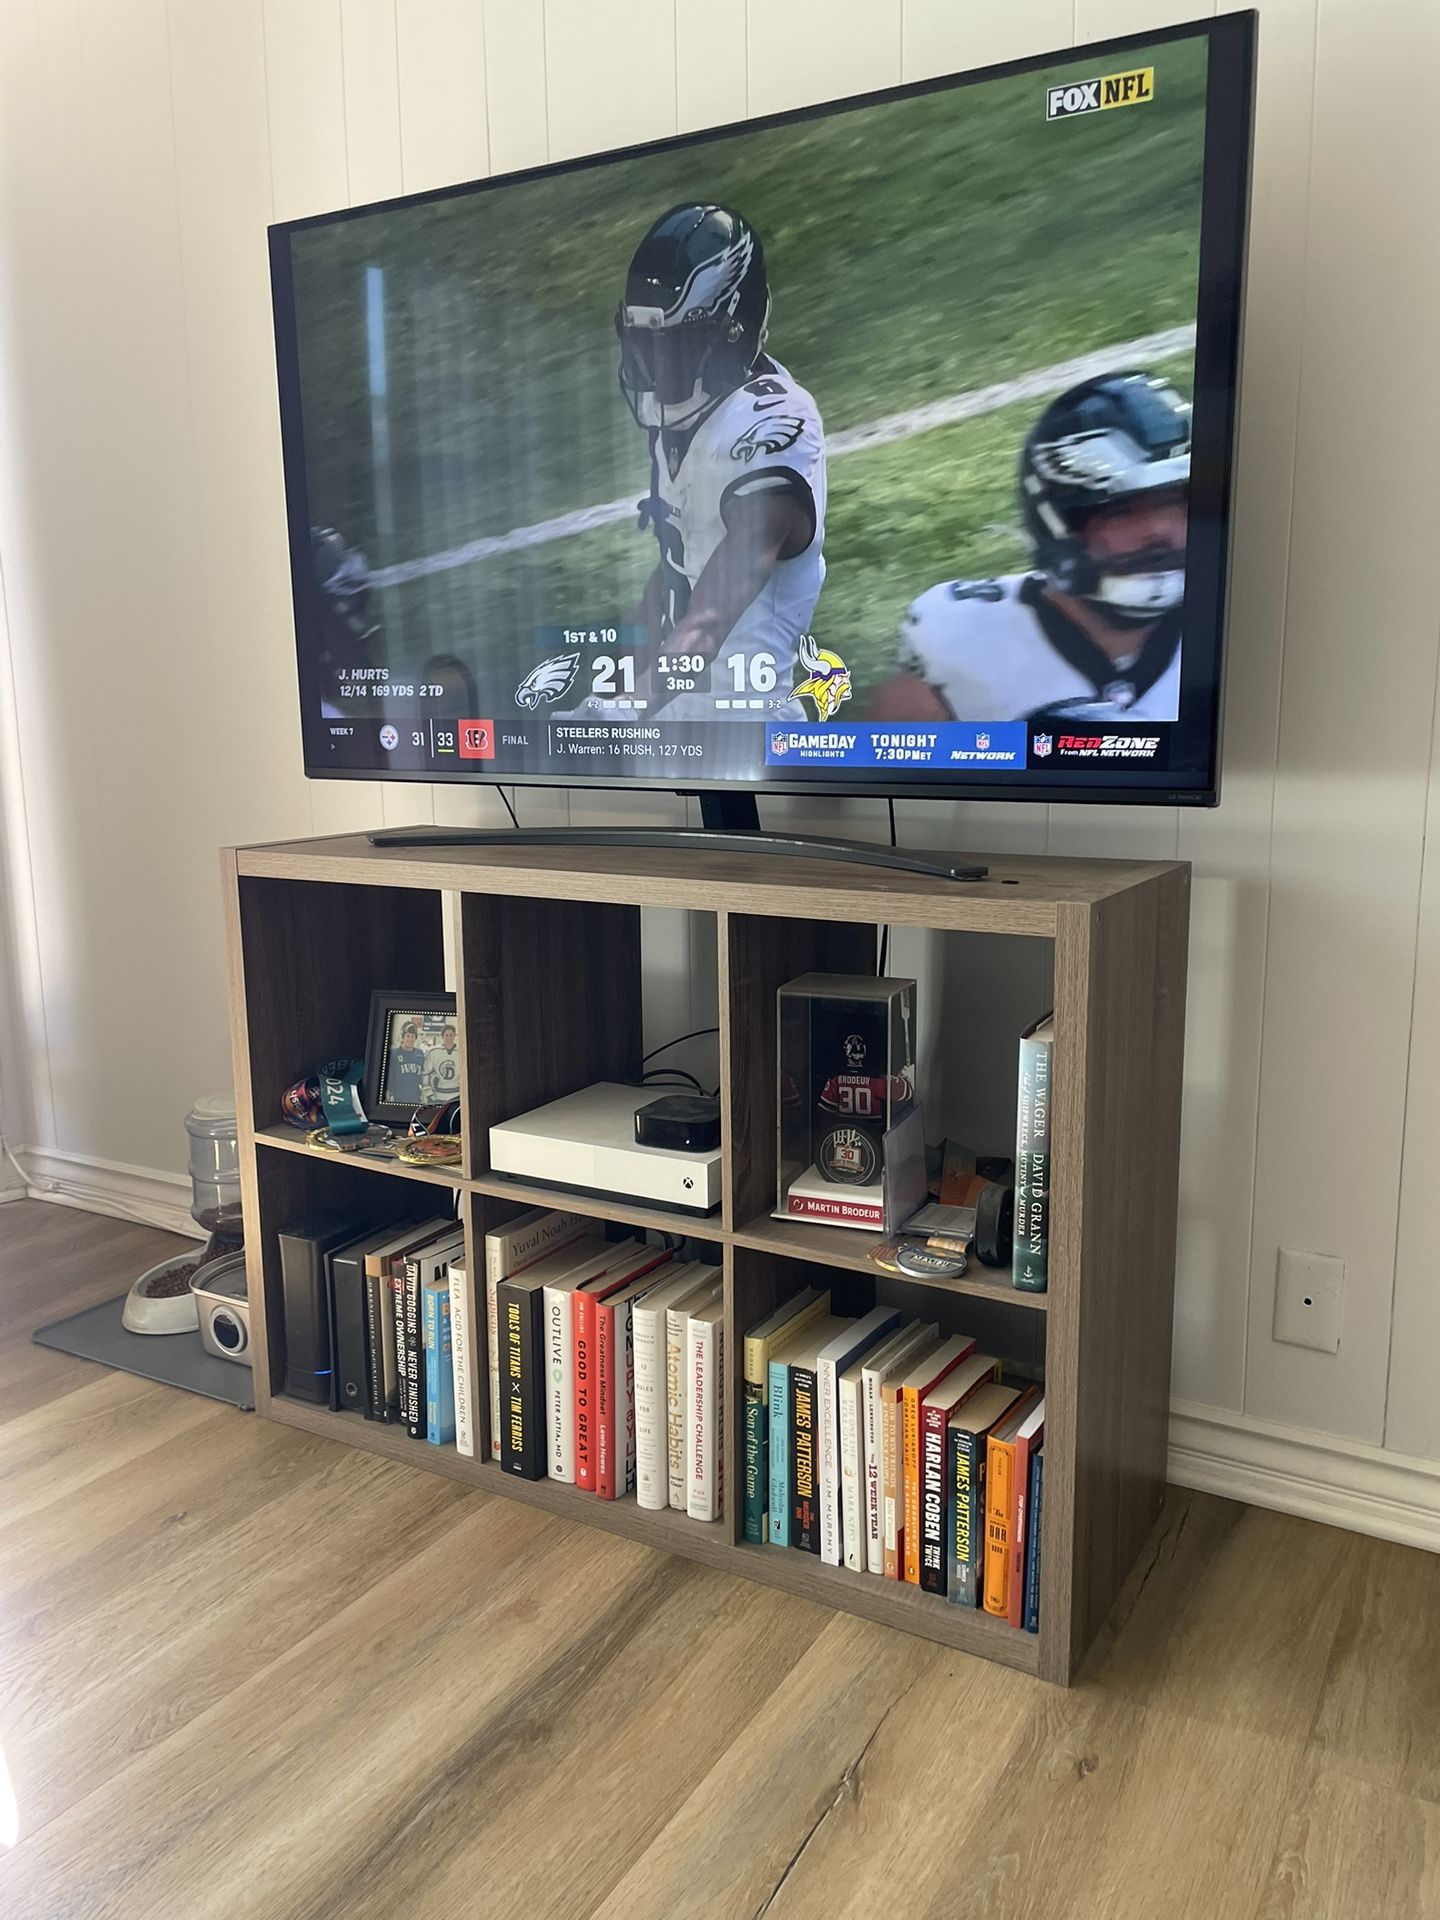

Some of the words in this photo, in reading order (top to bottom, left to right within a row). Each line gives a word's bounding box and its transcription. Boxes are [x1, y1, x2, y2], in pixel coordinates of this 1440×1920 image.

[1050, 82, 1099, 116] FOX
[1104, 73, 1150, 104] NFL
[563, 630, 587, 643] 1ST
[588, 631, 598, 643] &
[598, 629, 617, 643] 10
[338, 669, 349, 680] J.
[351, 669, 389, 680] HURTS
[592, 656, 635, 693] 21
[658, 655, 705, 673] 1:30
[727, 652, 777, 693] 16
[340, 686, 367, 697] 12/14
[371, 685, 390, 696] 169
[391, 685, 414, 697] YDS
[419, 686, 429, 697] 2
[429, 685, 444, 697] TD
[666, 677, 695, 690] 3RD
[768, 700, 781, 710] 3-2
[330, 728, 348, 736] WEEK
[412, 732, 425, 746] 31
[437, 732, 454, 747] 33
[502, 735, 528, 745] FINAL
[556, 727, 610, 739] STEELERS
[611, 728, 660, 740] RUSHING
[871, 734, 937, 747] TONIGHT
[556, 744, 565, 754] J.
[566, 744, 605, 755] Warren:
[608, 745, 621, 755] 16
[622, 745, 655, 757] RUSH,
[658, 745, 678, 756] 127
[679, 745, 703, 757] YDS
[800, 750, 845, 758] HIGHLIGHTS
[950, 750, 1016, 760] NETWORK
[1078, 749, 1099, 757] NFL
[1100, 749, 1155, 758] NETWORK
[838, 1075, 870, 1085] BRODEUR
[1035, 1051, 1048, 1083] THE
[839, 1087, 872, 1114] 30
[1033, 1087, 1046, 1138] WAGER
[841, 1149, 854, 1160] 30
[1032, 1153, 1044, 1200] DAVID
[807, 1201, 840, 1214] MARTIN
[842, 1204, 880, 1219] BRODEUR
[1017, 1199, 1027, 1236] MURDER
[512, 1231, 539, 1257] Yuval
[1030, 1202, 1043, 1256] GRANN
[406, 1263, 416, 1293] DAVID
[394, 1278, 403, 1317] EXTREME
[488, 1288, 497, 1335] Sapiens
[406, 1293, 417, 1334] GOGGINS
[427, 1319, 435, 1330] TO
[508, 1302, 520, 1331] TOOLS
[396, 1319, 406, 1376] OWNERSHIP
[428, 1330, 436, 1350] RUN
[509, 1332, 520, 1345] OF
[551, 1306, 562, 1365] OUTLIVE
[695, 1341, 704, 1360] THE
[407, 1350, 418, 1380] NEVER
[454, 1307, 462, 1331] ACID
[458, 1375, 466, 1423] CHILDREN
[510, 1346, 521, 1378] TITANS
[577, 1339, 587, 1381] GOOD
[599, 1333, 607, 1379] Greatness
[668, 1343, 682, 1408] Atomic
[823, 1362, 831, 1395] INNER
[408, 1381, 419, 1423] FINISHED
[510, 1394, 522, 1412] TIM
[578, 1388, 588, 1407] TO
[599, 1379, 607, 1416] Mindset
[695, 1361, 704, 1422] LEADERSHIP
[773, 1385, 784, 1418] Blink
[746, 1406, 758, 1428] Son
[796, 1389, 811, 1428] JAMES
[511, 1413, 523, 1452] FERRISS
[578, 1413, 588, 1463] GREAT
[669, 1412, 684, 1469] Habits
[746, 1430, 758, 1443] of
[824, 1398, 833, 1468] EXCELLENCE
[555, 1444, 562, 1458] MD
[695, 1424, 704, 1480] CHALLENGE
[746, 1443, 758, 1463] the
[797, 1430, 813, 1498] PATTERSON
[925, 1431, 942, 1493] HARLAN
[746, 1464, 758, 1498] Game
[868, 1463, 878, 1479] 12
[956, 1451, 970, 1490] JAMES
[770, 1478, 778, 1513] Gladwell
[777, 1481, 785, 1514] Malcolm
[847, 1486, 855, 1513] MARK
[869, 1480, 878, 1511] WEEK
[848, 1516, 856, 1541] NEPO
[870, 1512, 879, 1540] YEAR
[925, 1493, 942, 1541] COBEN
[956, 1492, 970, 1562] PATTERSON
[924, 1544, 932, 1567] TWICE
[933, 1546, 941, 1570] THINK
